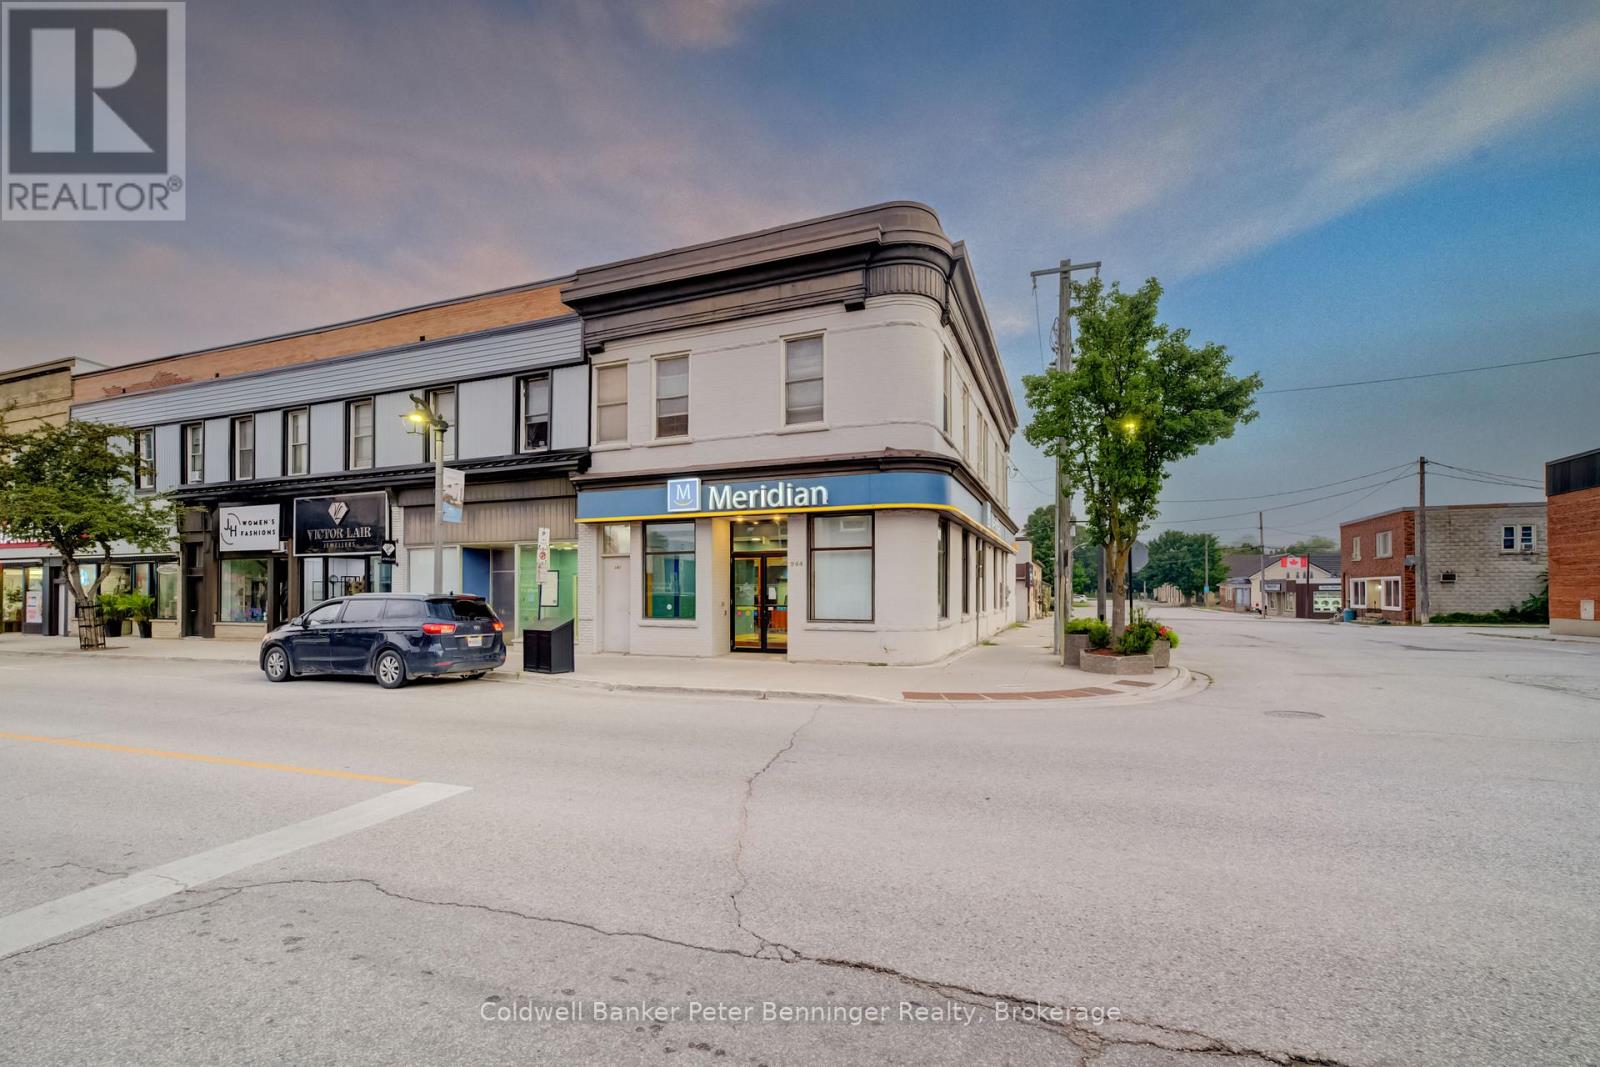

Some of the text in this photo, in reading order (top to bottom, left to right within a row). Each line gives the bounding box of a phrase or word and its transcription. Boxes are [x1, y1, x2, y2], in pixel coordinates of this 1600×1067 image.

[676, 483, 691, 500] M
[708, 482, 828, 510] Meridian
[241, 529, 276, 537] FASHIONS
[307, 526, 372, 540] VICTOR LAIR
